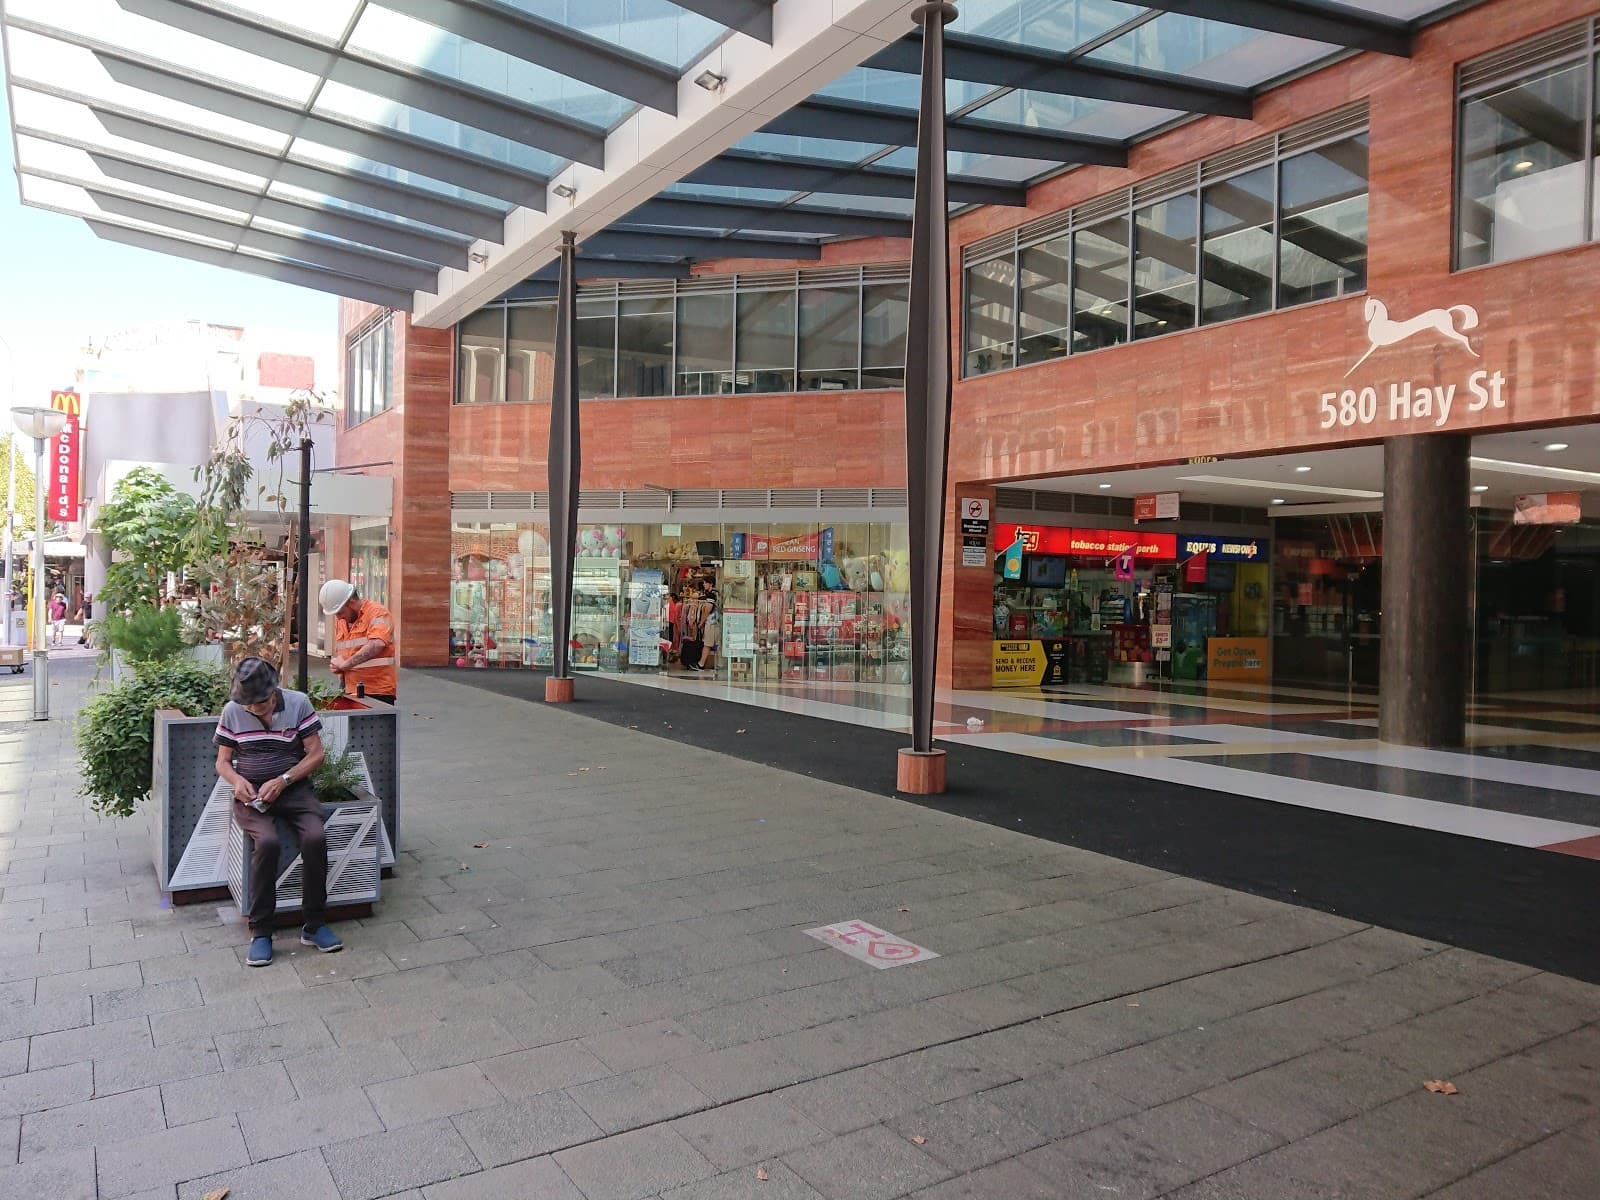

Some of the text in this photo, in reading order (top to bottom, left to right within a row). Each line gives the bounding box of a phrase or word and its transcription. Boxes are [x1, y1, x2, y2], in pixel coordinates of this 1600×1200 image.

[1321, 370, 1506, 429] 580 Hay St
[58, 422, 73, 517] McDonald's
[786, 545, 816, 553] GINSENG
[1070, 540, 1105, 551] tobacco
[1136, 545, 1159, 555] perth
[995, 664, 1036, 673] MONEY HERE
